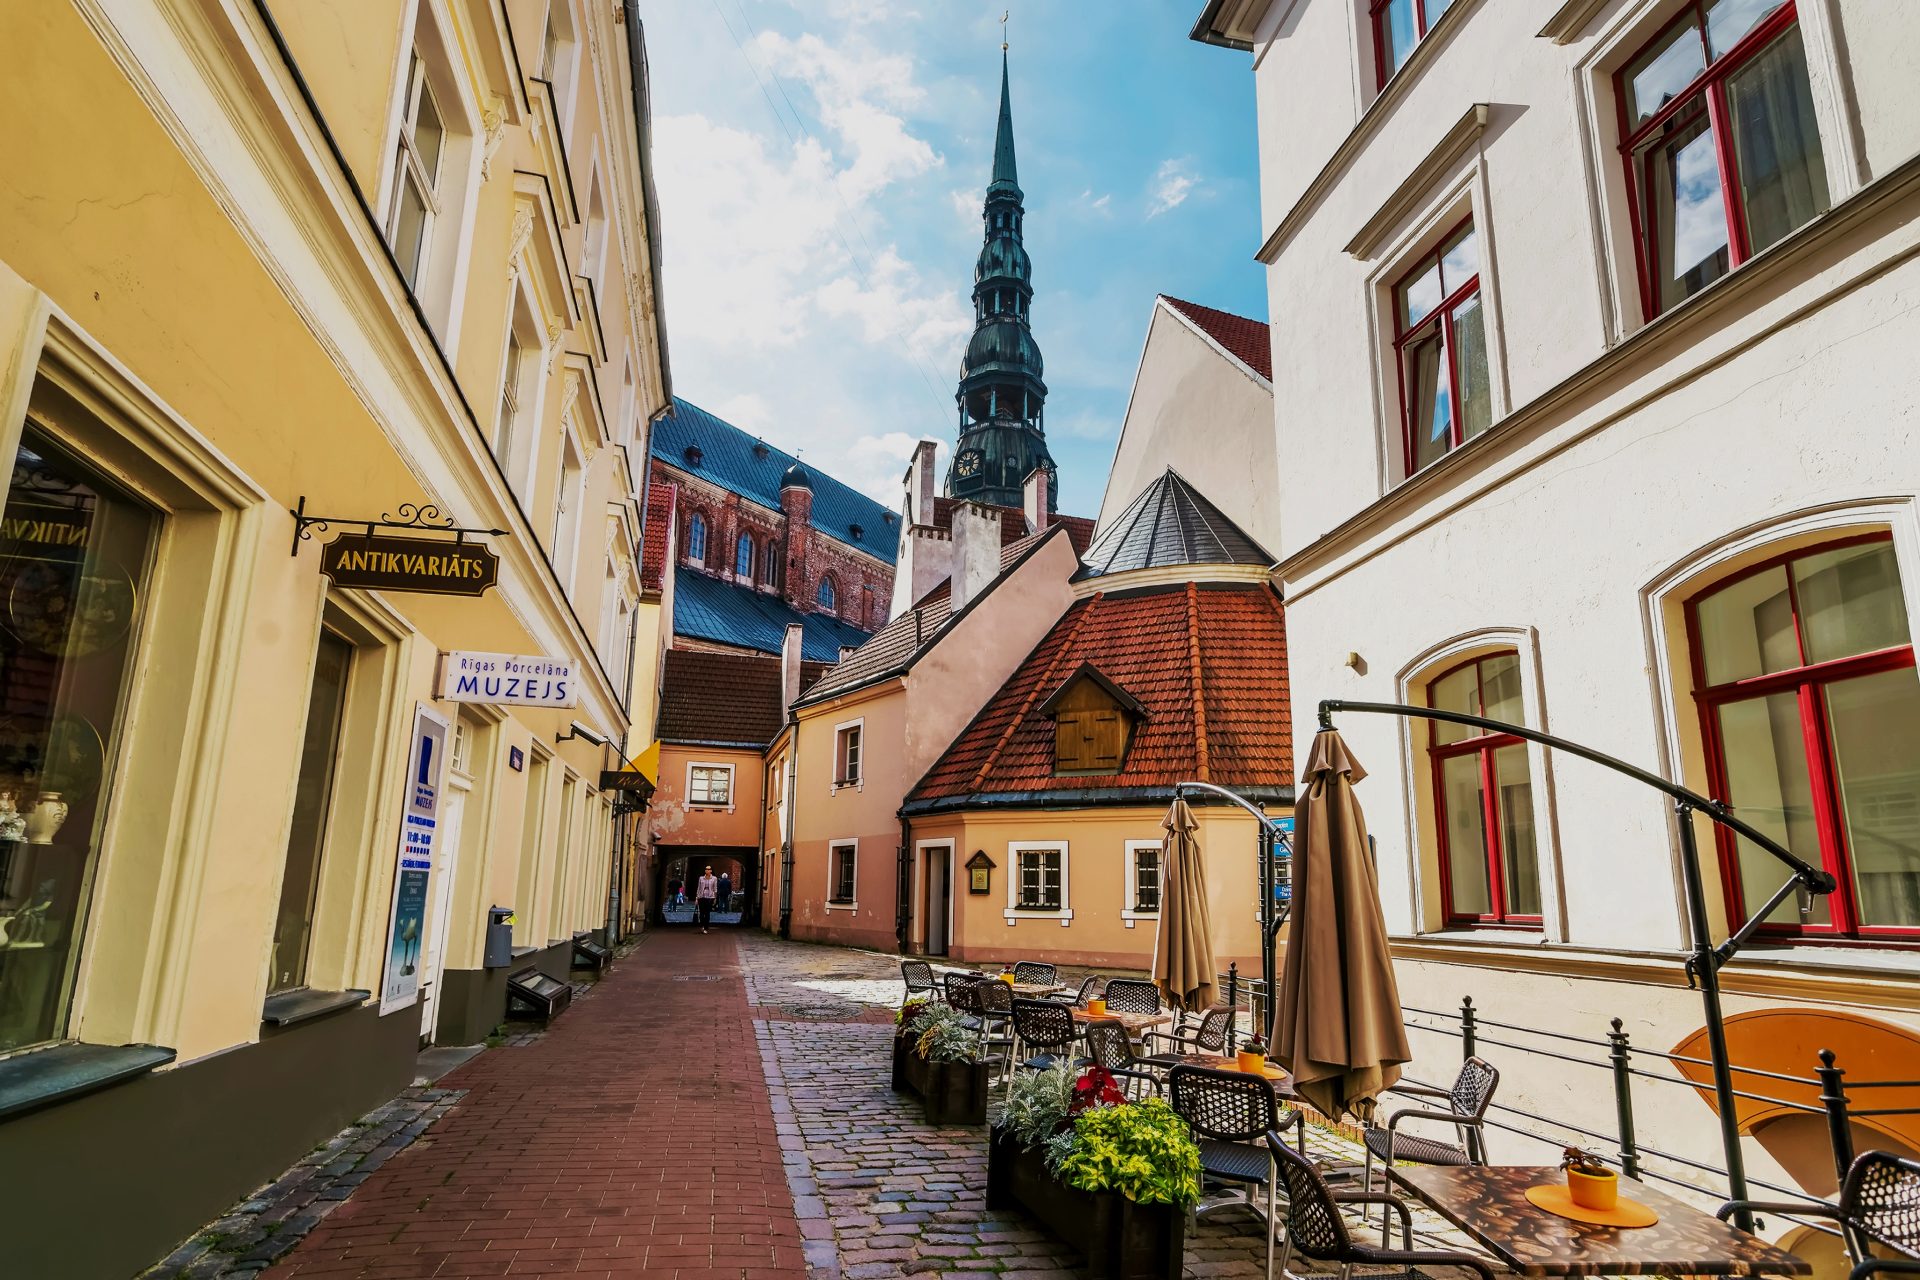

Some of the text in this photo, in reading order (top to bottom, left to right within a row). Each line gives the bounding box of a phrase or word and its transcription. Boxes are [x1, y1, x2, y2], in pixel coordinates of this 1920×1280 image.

[336, 550, 483, 579] ANTIKVARIĀTS
[461, 658, 568, 676] Rīgas Porcelāna
[456, 675, 566, 700] MUZEJS
